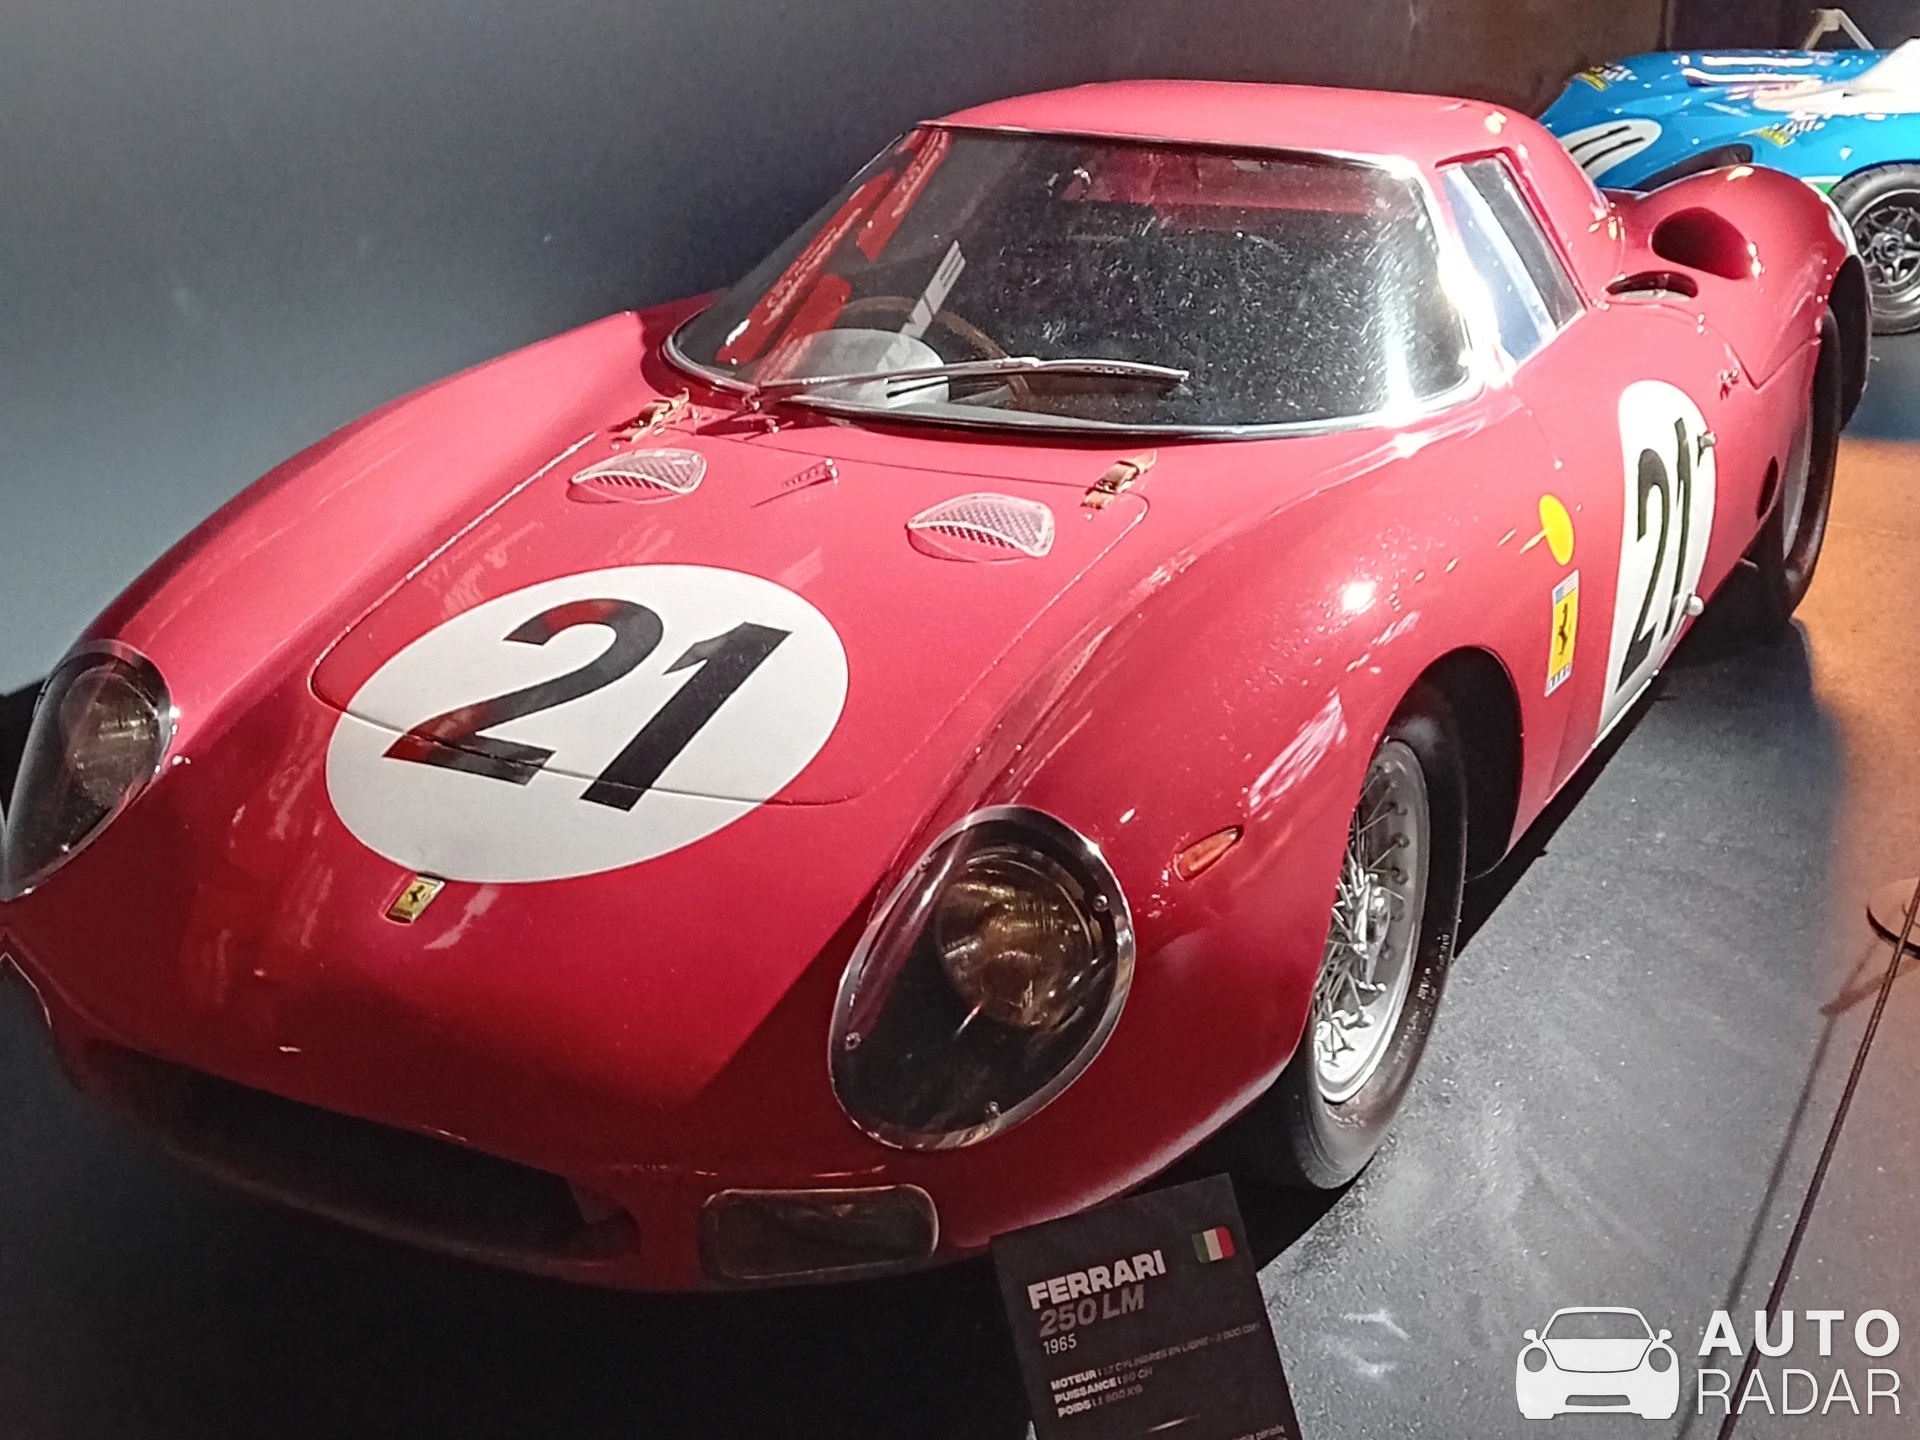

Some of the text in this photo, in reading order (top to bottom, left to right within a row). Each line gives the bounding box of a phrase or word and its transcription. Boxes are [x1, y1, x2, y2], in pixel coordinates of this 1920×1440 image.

[1615, 416, 1692, 694] 21
[382, 597, 793, 813] 21
[1027, 1250, 1167, 1310] FERRARI
[1038, 1284, 1146, 1338] 250 LM
[1042, 1333, 1078, 1355] 1965
[1050, 1369, 1097, 1391] MOTEUR
[1054, 1377, 1117, 1405] PUISSANCE
[1057, 1399, 1092, 1418] POIDS
